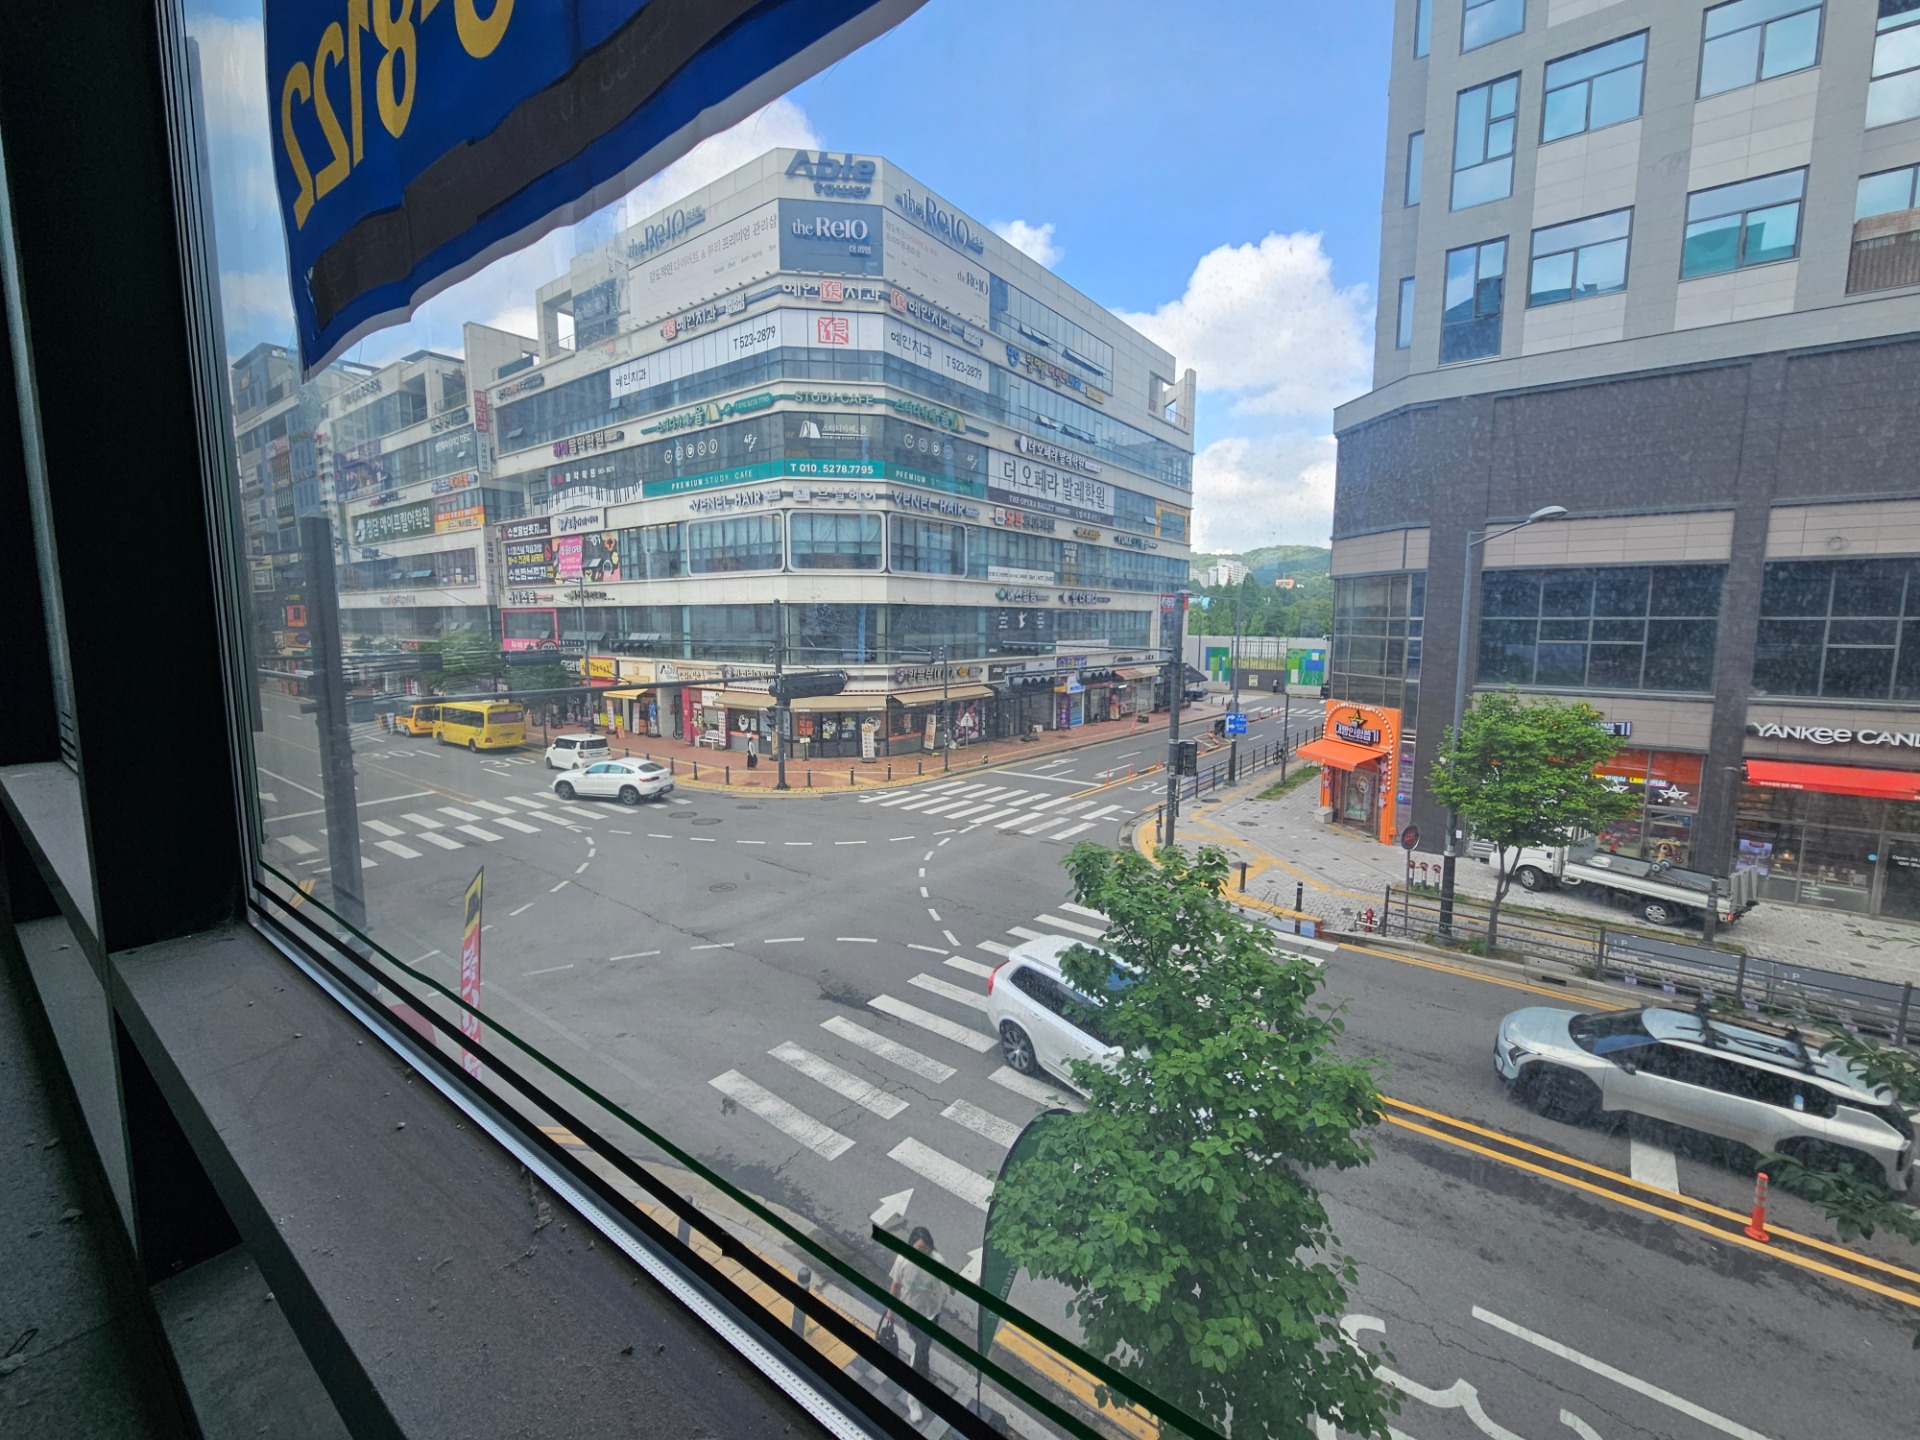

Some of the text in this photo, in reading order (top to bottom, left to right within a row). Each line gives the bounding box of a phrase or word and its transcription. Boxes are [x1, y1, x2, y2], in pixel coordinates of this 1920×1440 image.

[784, 149, 876, 184] Able
[814, 182, 871, 198] tower
[792, 217, 868, 239] the Re10
[782, 281, 820, 298] 예인
[845, 287, 881, 302] 치과
[676, 304, 717, 332] 예인치과
[908, 300, 953, 333] 예인치과
[739, 326, 777, 349] 523-2879
[890, 332, 933, 360] 예인치과
[615, 367, 647, 388] 예인치과
[951, 358, 983, 381] 523-2879
[795, 390, 875, 405] STUDY CAFE
[790, 463, 797, 472] T
[895, 469, 926, 484] PREMIUM
[671, 469, 753, 490] PREMIUM STUDY CAFE
[1003, 459, 1105, 509] 더 오페라 발레학원
[692, 490, 762, 512] VENEL HAIR
[892, 490, 965, 516] VENEL HAIR
[1008, 494, 1020, 504] THE
[1020, 496, 1037, 508] OPERA
[479, 756, 536, 768] 30
